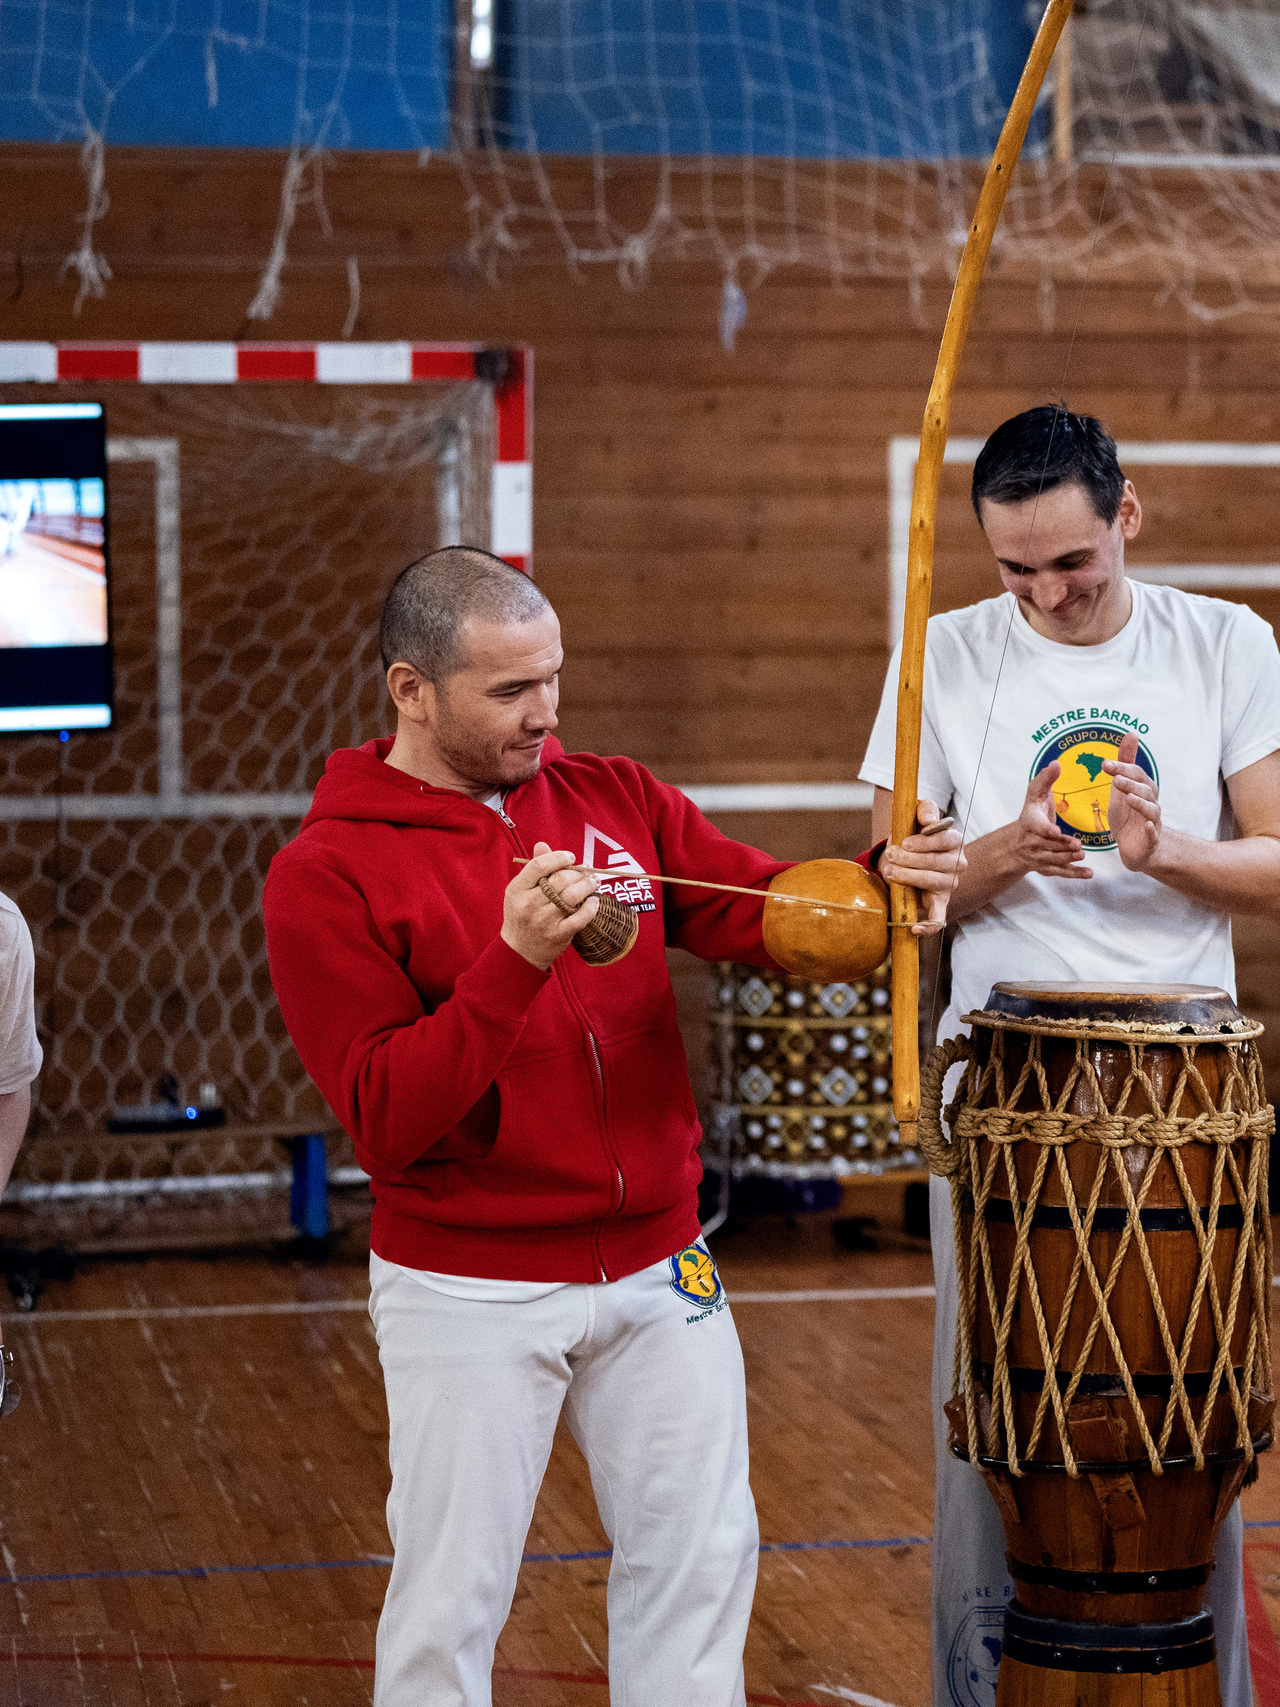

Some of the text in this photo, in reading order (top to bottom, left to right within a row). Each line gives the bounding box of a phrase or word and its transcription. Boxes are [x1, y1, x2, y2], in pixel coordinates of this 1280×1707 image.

[1031, 708, 1086, 743] MESTRE
[1058, 731, 1098, 750] GRUPO
[595, 879, 652, 894] RACIE
[616, 890, 654, 903] RRA
